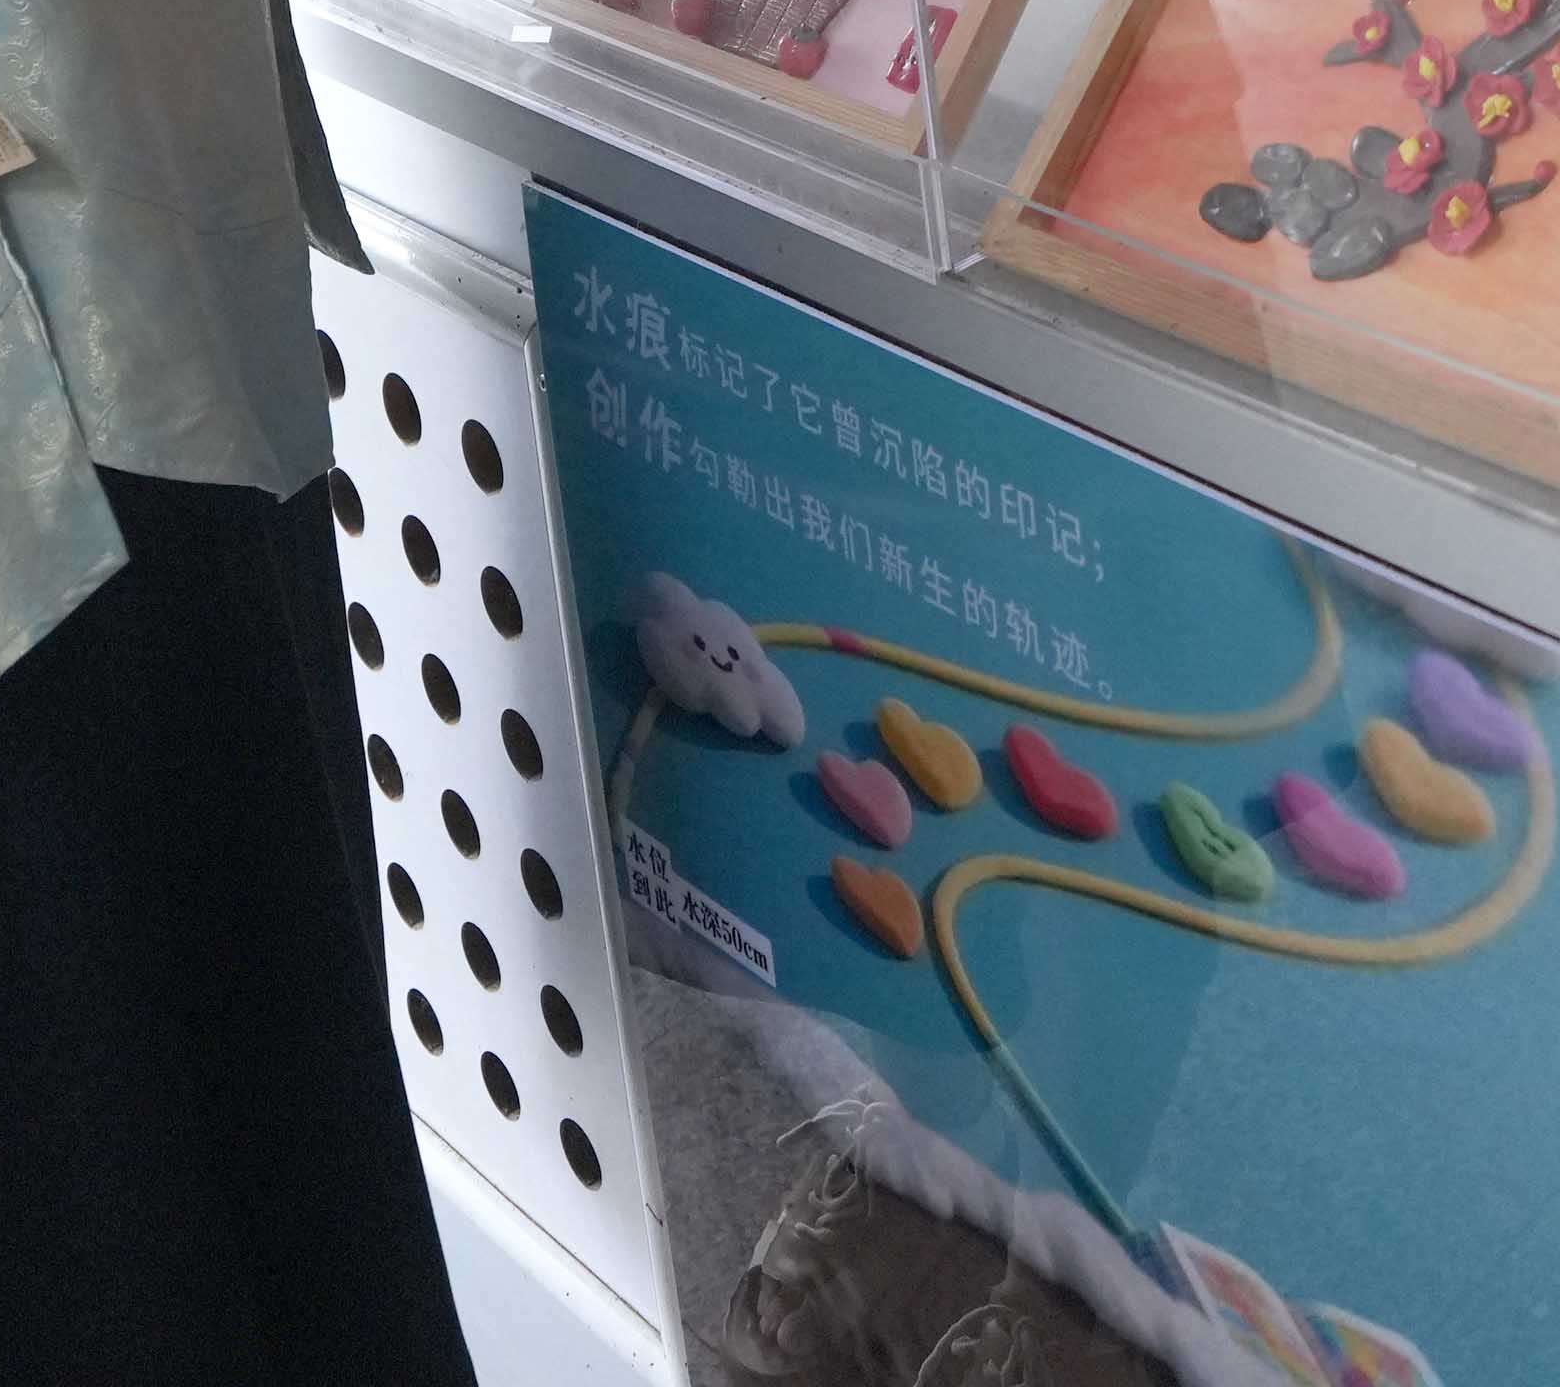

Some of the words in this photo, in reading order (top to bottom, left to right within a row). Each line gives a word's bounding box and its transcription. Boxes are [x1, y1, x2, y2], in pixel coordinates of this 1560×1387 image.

[628, 832, 670, 884] 水位
[632, 870, 677, 924] 到此
[681, 890, 769, 972] 水深50cm
